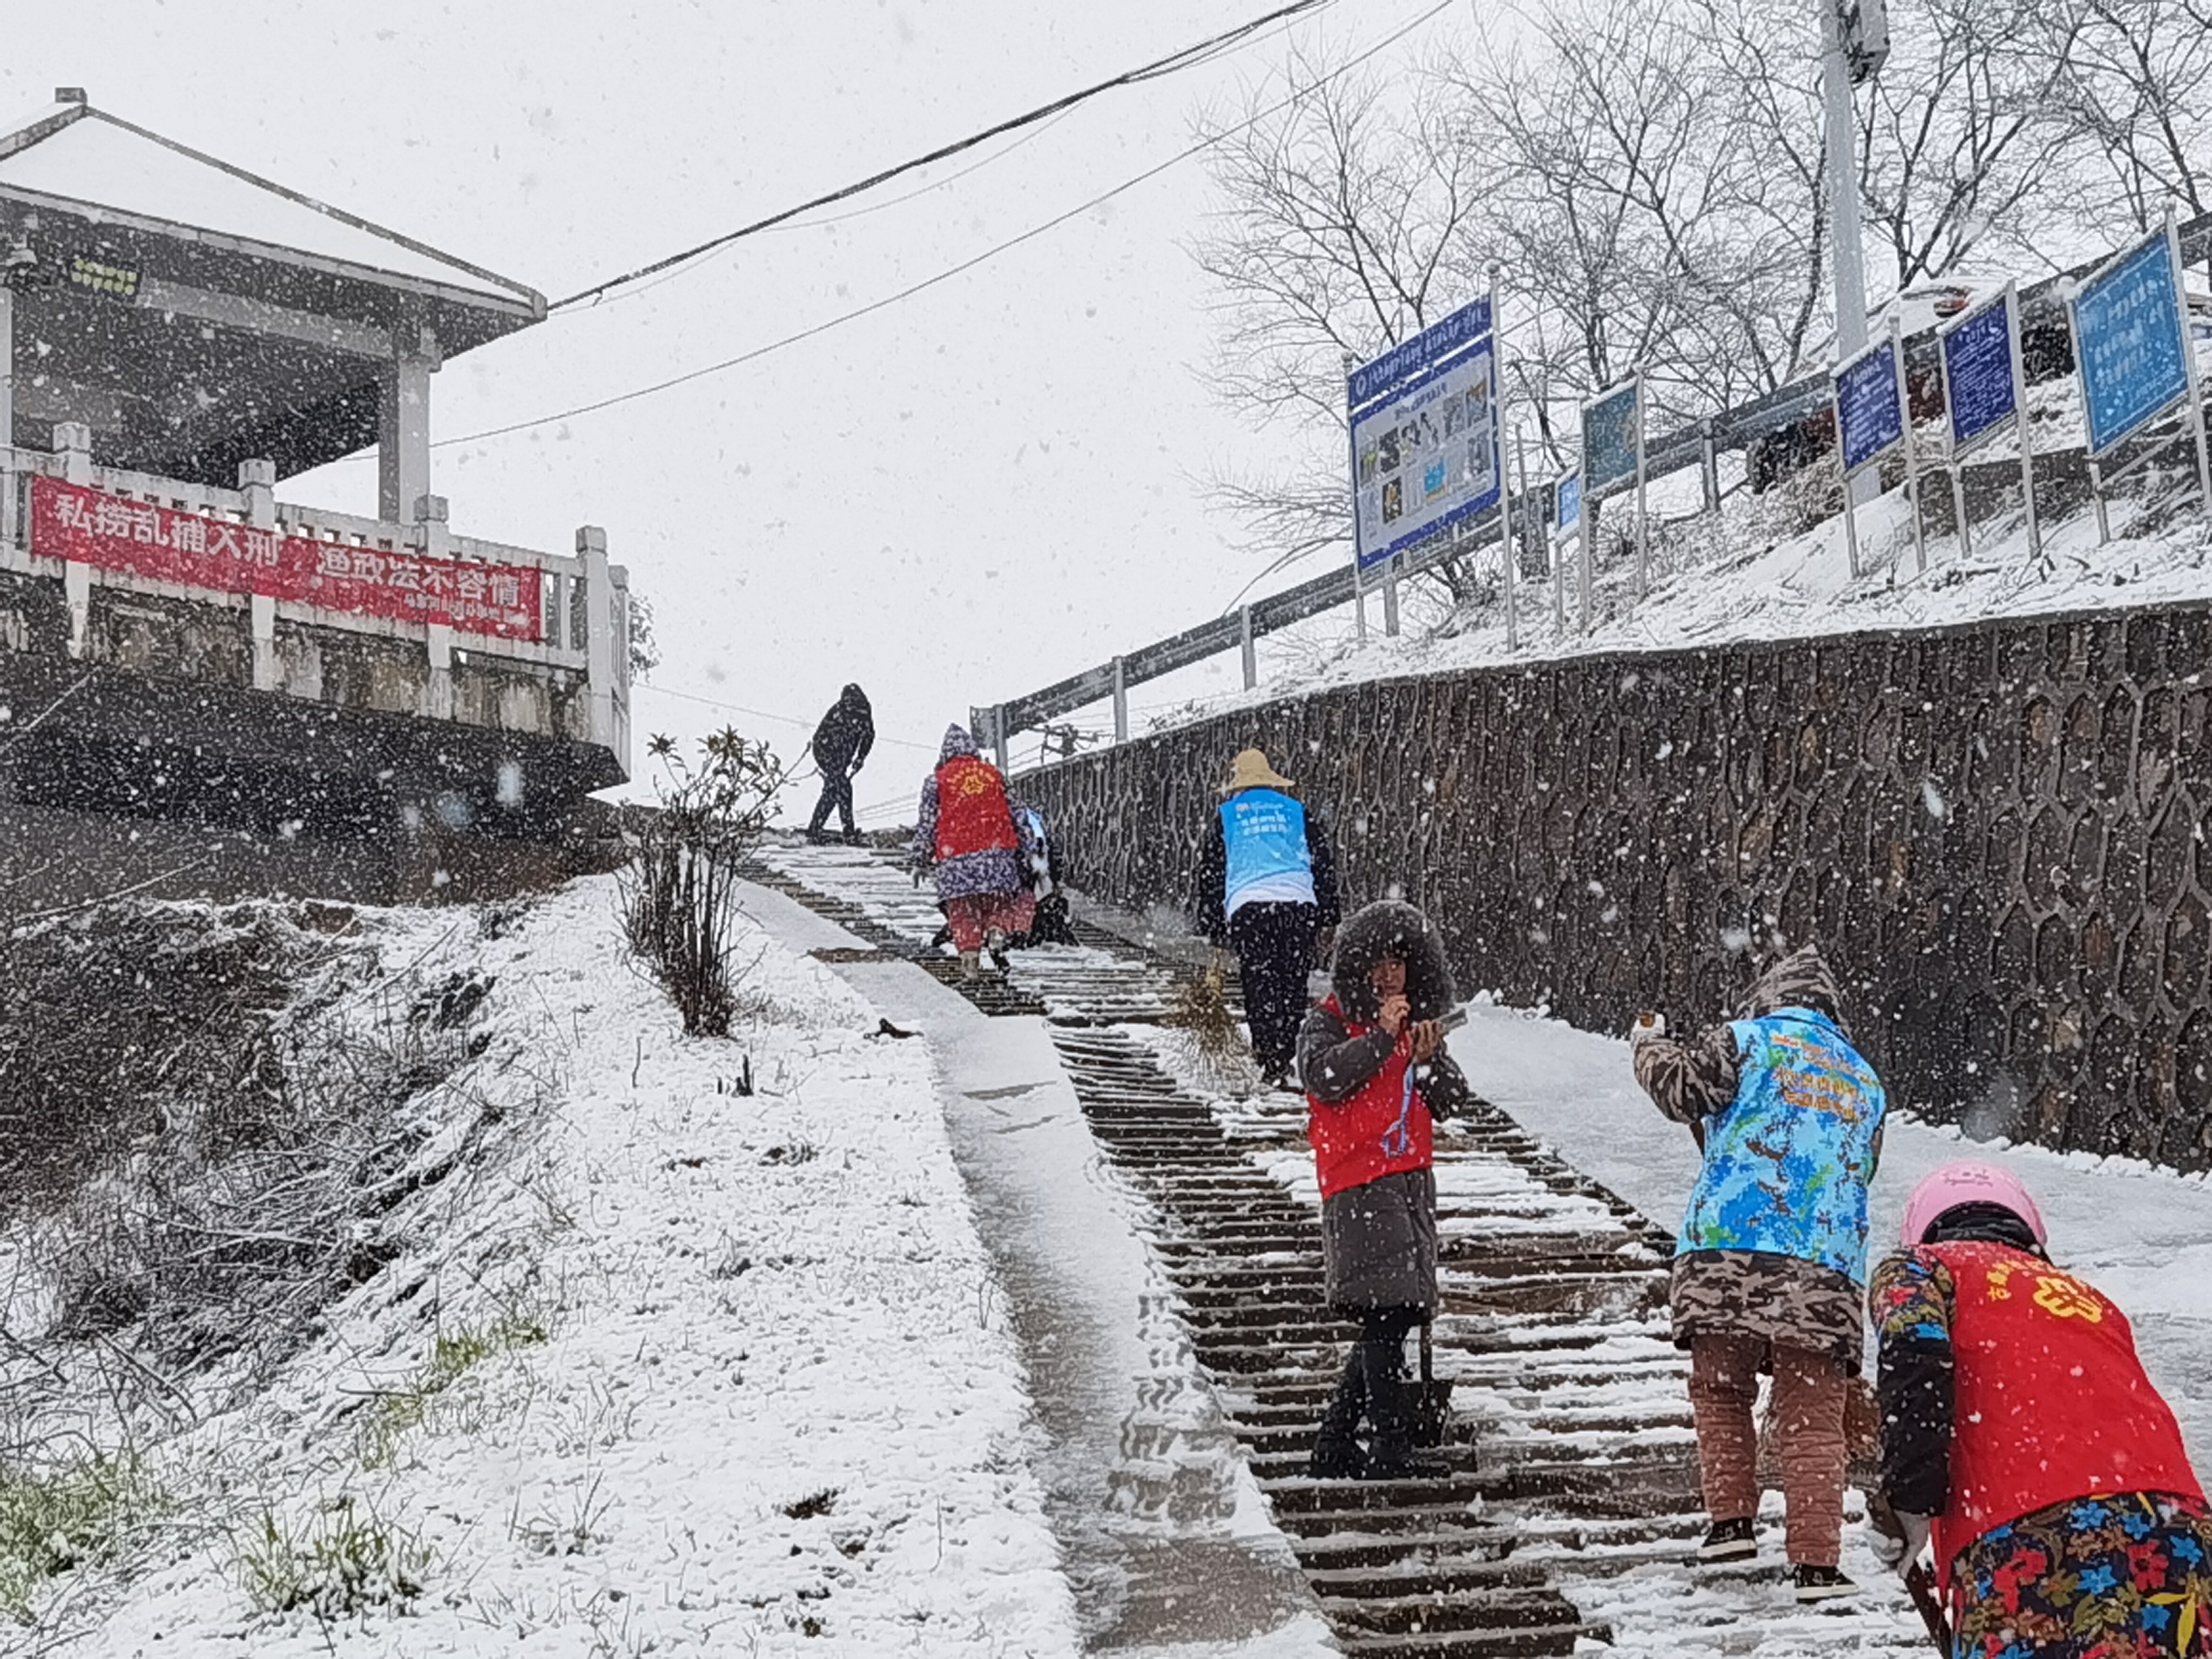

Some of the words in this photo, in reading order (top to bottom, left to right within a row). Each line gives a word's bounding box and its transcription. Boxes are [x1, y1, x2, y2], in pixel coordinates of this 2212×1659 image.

[317, 542, 520, 608] 渔政法不容情
